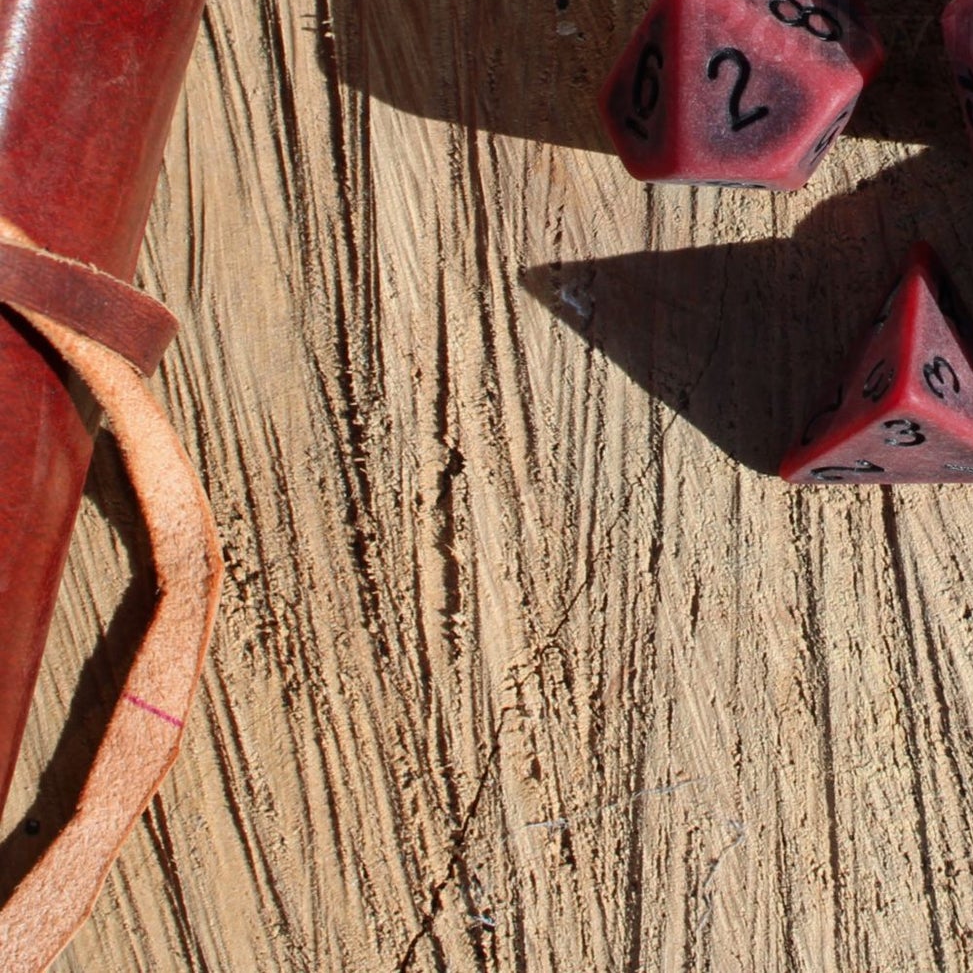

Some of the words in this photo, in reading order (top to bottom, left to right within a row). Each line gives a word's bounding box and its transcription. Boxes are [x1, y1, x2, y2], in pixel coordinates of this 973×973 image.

[707, 47, 770, 133] 2
[922, 355, 960, 400] 3
[882, 418, 927, 448] 3
